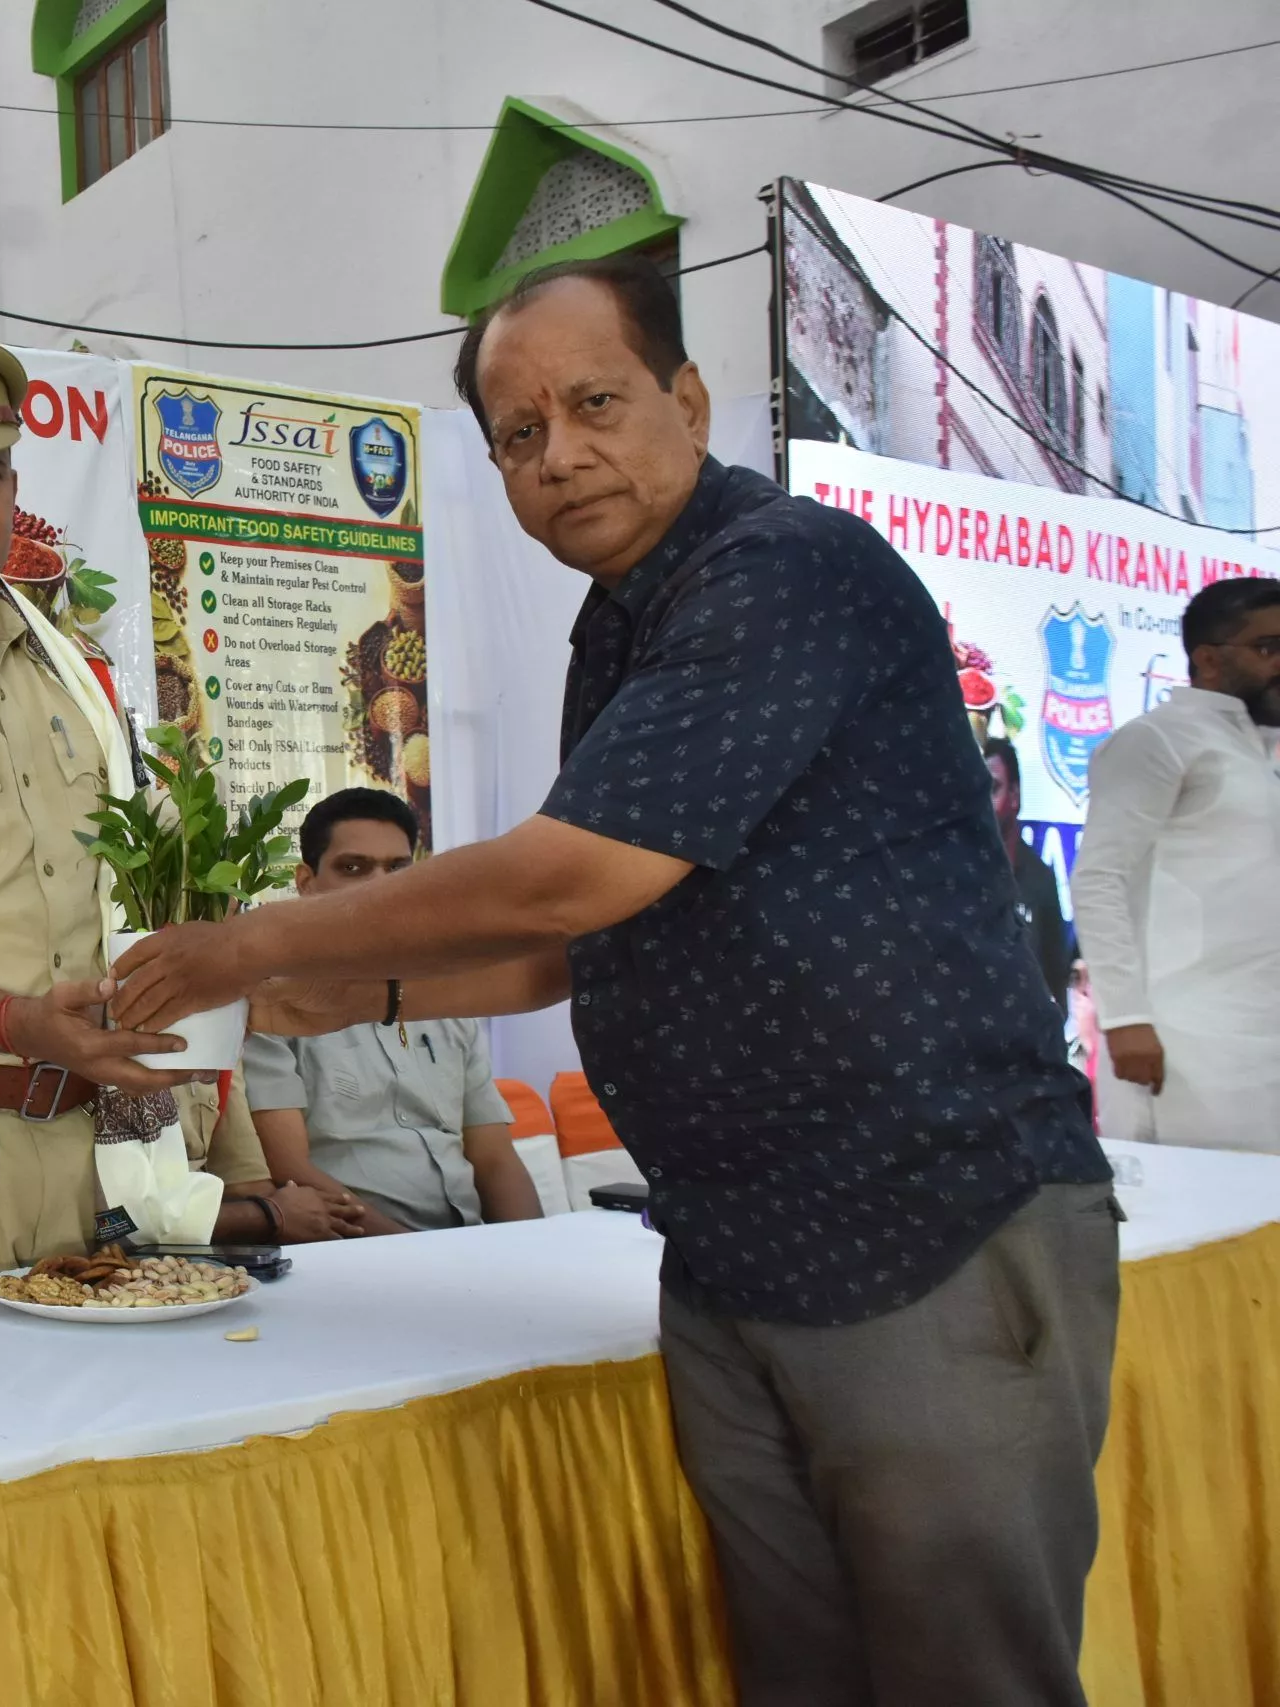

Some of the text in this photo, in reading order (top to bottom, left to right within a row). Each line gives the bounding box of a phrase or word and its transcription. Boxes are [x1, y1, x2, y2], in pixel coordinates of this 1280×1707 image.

[165, 427, 214, 441] TELANGANA
[228, 401, 340, 455] fssai
[163, 438, 218, 459] POLICE
[251, 457, 322, 476] FOOD SAFETY
[251, 473, 323, 492] & STANDARDS
[235, 487, 339, 509] AUTHORITY OF INDIA
[150, 509, 417, 552] IMPORTANT FOOD SAFETY GUIDELINES
[889, 494, 1075, 575] HYDERABAD
[1086, 529, 1194, 600] KIRANA
[220, 551, 339, 574] Keep your Premises Clean
[221, 570, 367, 594] & Maintain regular Pest Control
[222, 593, 332, 613] Clean all Storage Racks
[223, 613, 339, 634] and Containers Regularly
[224, 636, 338, 656] Do not Overload Storage
[224, 655, 251, 668] Areas
[225, 678, 333, 695] Cover any Cuts or Burn
[226, 696, 339, 714] Wounds with Waterproof
[1046, 695, 1111, 732] POLICE
[227, 715, 273, 731] Bandages
[228, 738, 345, 754] Sell Only FSSAI Licensed
[229, 758, 271, 771] Products
[230, 781, 265, 796] Strictly
